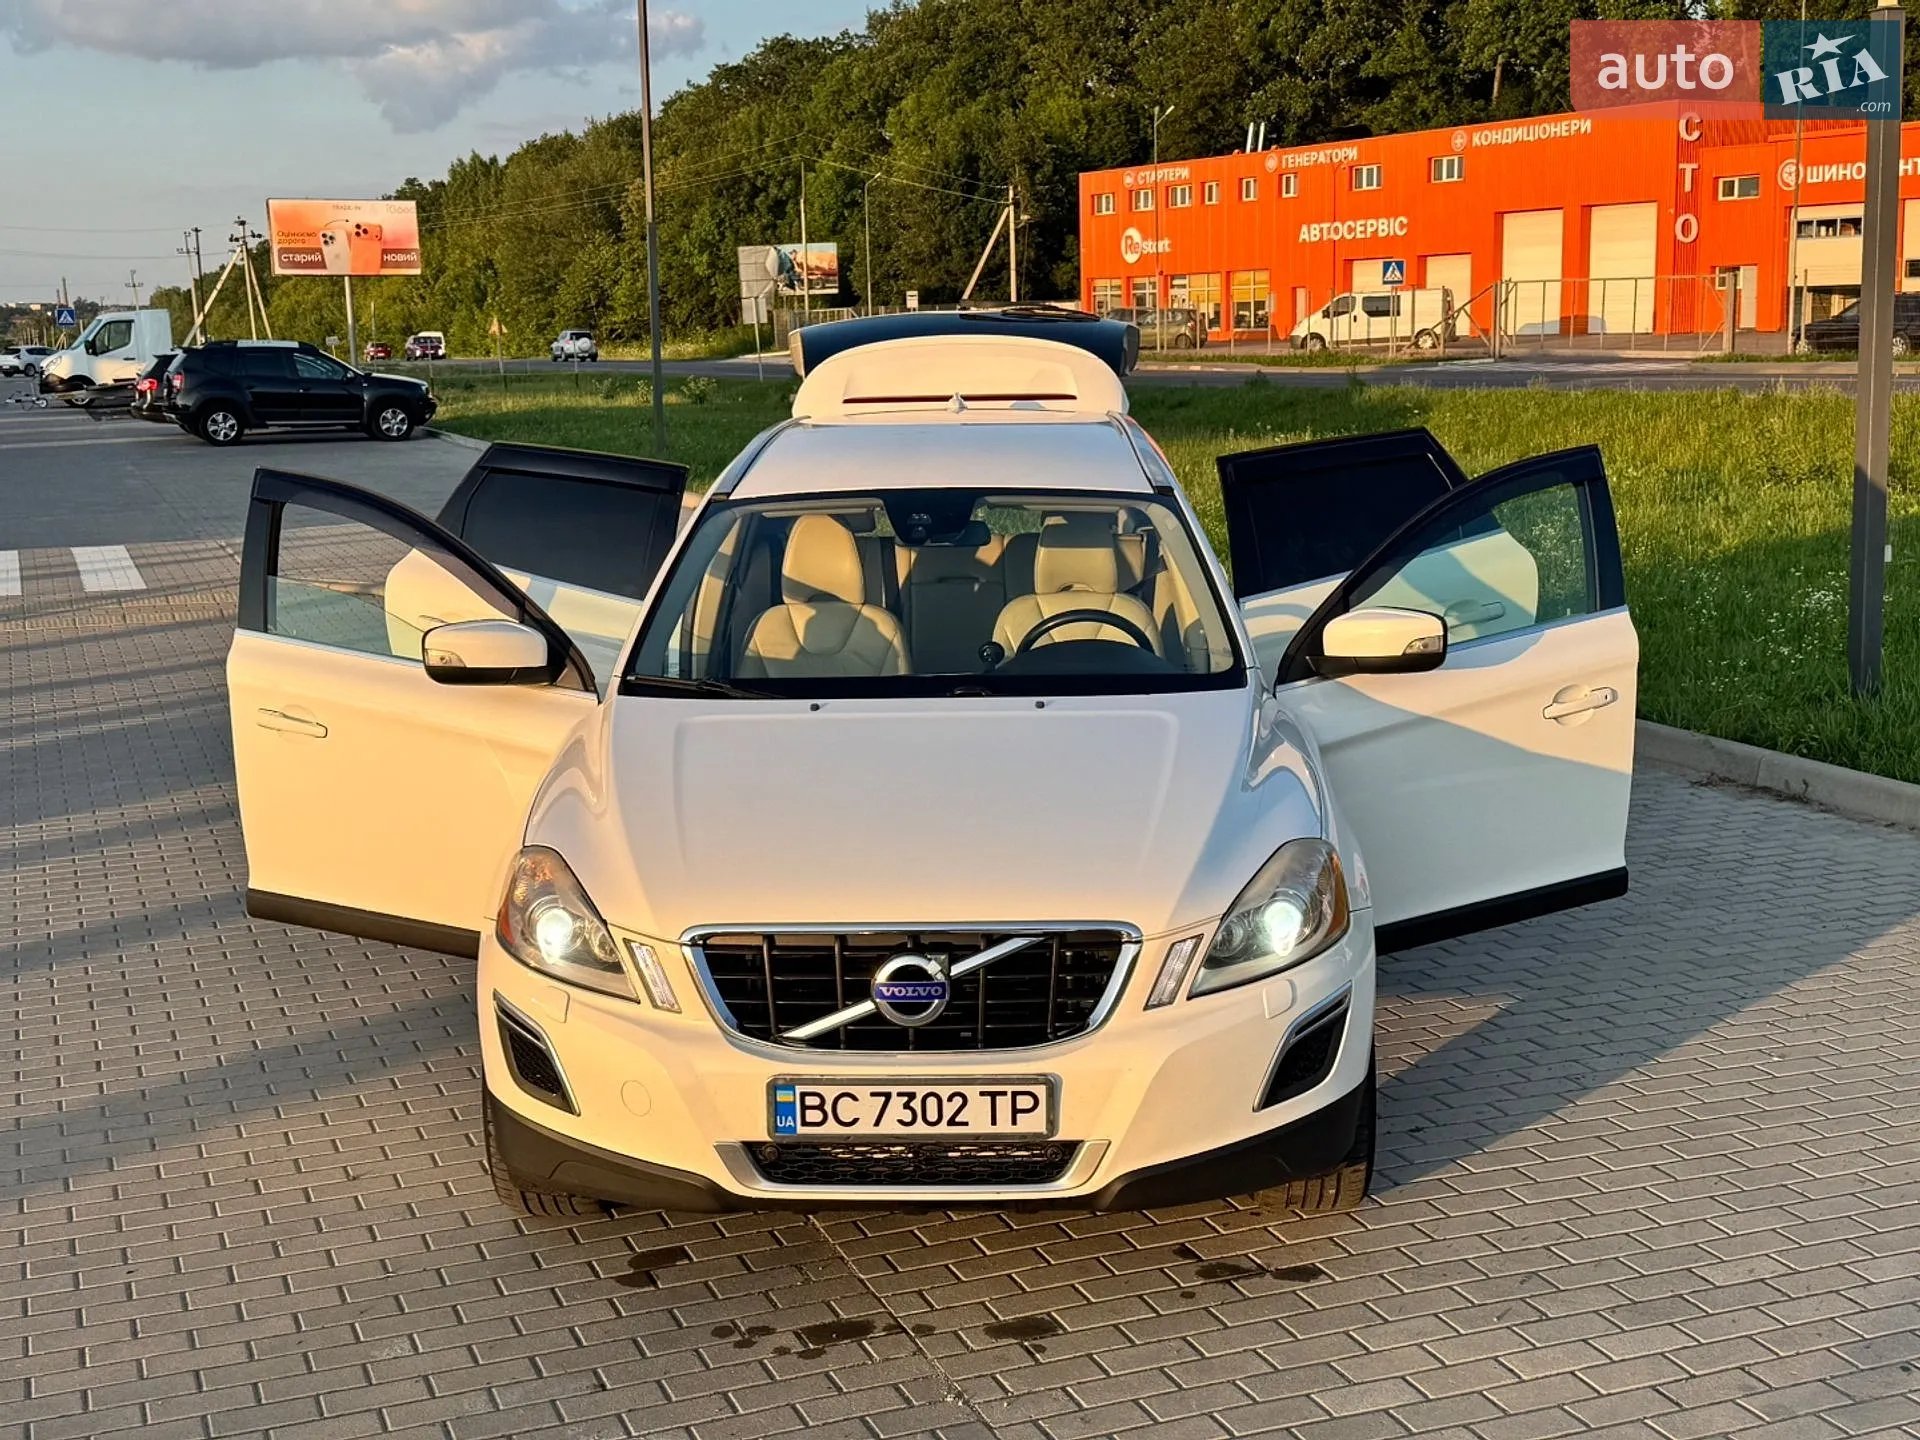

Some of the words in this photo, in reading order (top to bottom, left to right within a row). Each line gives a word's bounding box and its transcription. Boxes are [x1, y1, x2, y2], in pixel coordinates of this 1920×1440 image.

[1472, 119, 1592, 147] КОНДИЦІОНЕРИ
[1282, 146, 1358, 169] ГЕНЕРАТОРИ
[1137, 167, 1190, 185] СТАРТЕРИ
[1675, 112, 1702, 243] СТО
[1299, 215, 1408, 243] АВТОСЕРВІС
[281, 252, 322, 264] старий
[383, 252, 417, 262] новий
[879, 986, 942, 996] VOLVO
[800, 1091, 860, 1127] BC
[870, 1091, 969, 1127] 7302
[979, 1091, 1040, 1127] TP
[777, 1115, 795, 1127] UA
